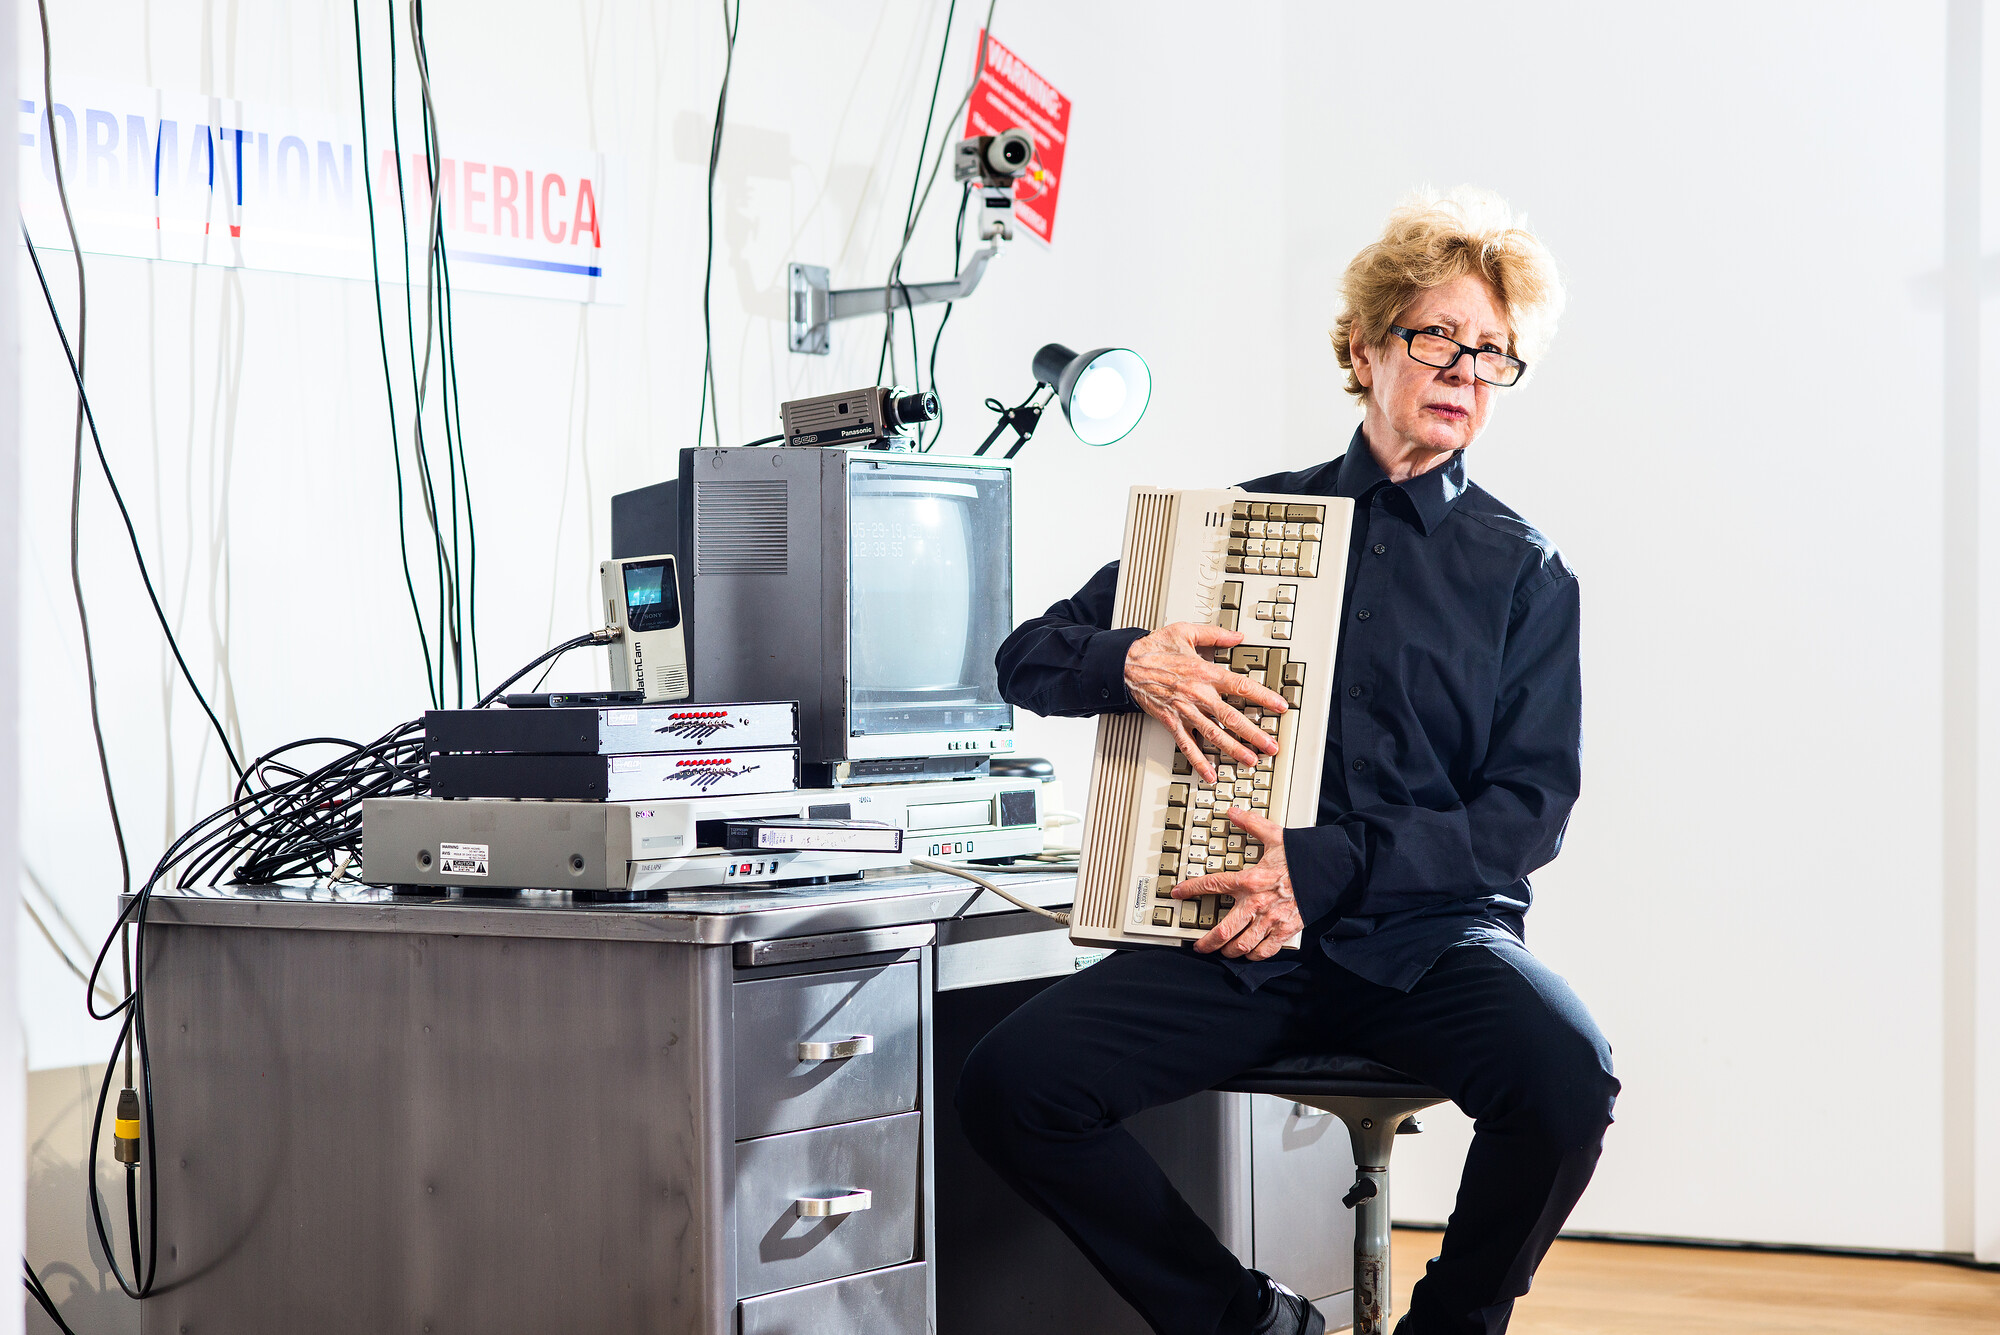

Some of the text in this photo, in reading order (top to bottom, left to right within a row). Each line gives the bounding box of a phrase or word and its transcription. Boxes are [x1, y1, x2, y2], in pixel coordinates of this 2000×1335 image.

[372, 149, 601, 248] AMERICA
[841, 426, 873, 437] Panasonic
[792, 434, 818, 446] CCD
[853, 541, 904, 557] 12:39:55
[1001, 739, 1013, 748] RGB
